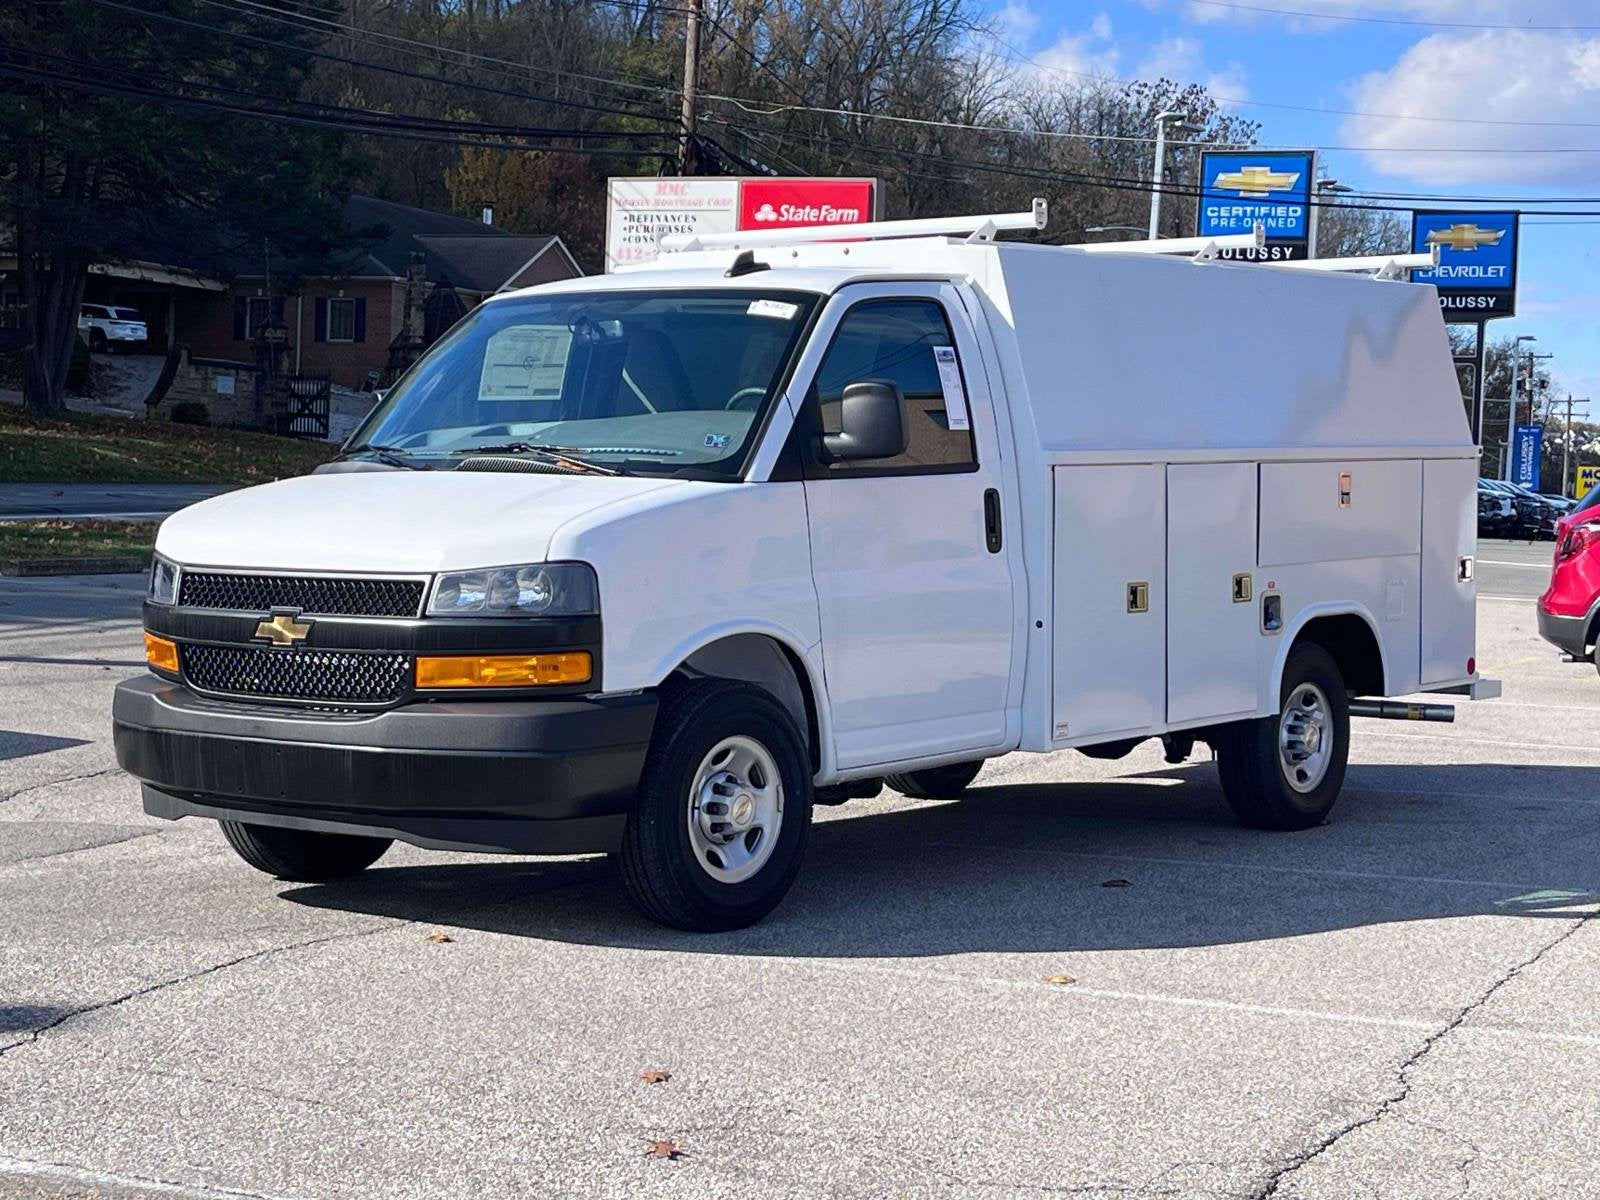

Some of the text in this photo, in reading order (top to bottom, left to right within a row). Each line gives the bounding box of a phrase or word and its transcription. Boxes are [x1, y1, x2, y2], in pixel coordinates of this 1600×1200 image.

[1206, 206, 1302, 217] CERTIFIED
[1217, 246, 1293, 260] OLUSSY
[1419, 265, 1507, 278] CHEVROLET
[1438, 296, 1496, 308] OLUSSY
